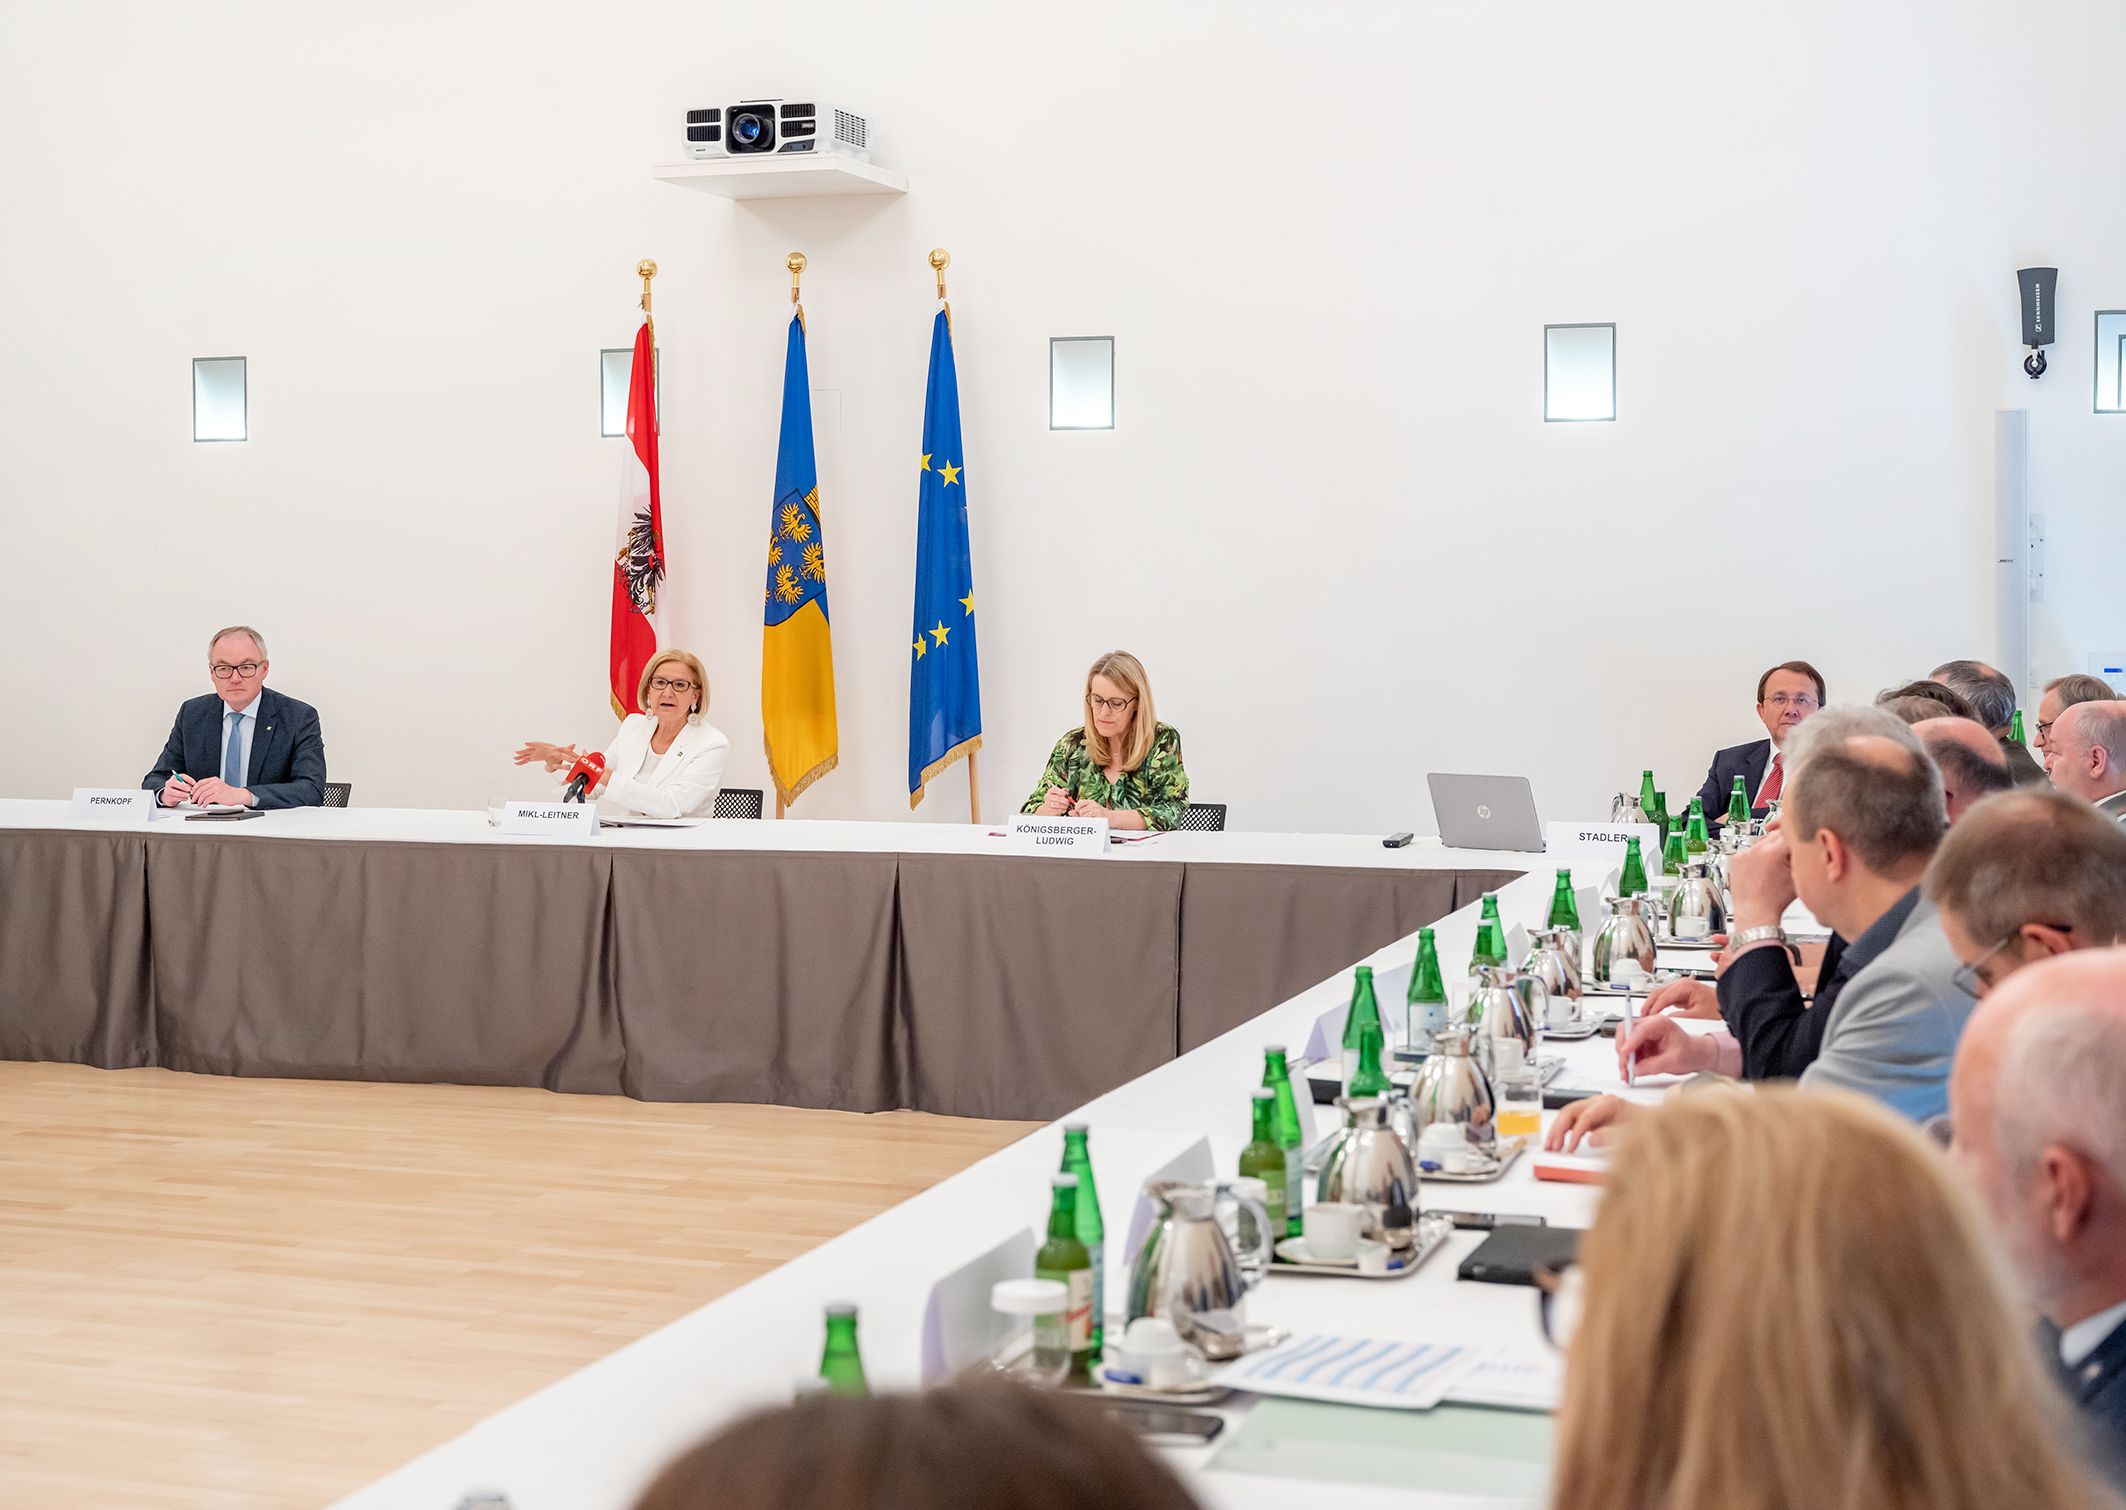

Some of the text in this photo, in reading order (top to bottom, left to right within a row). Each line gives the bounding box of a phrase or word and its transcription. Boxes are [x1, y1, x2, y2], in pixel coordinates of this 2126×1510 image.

[89, 796, 133, 805] PERNKOPF
[517, 810, 580, 819] MIKL-LEITNER
[1016, 823, 1097, 835] KÖNIGSBERGER-
[1035, 836, 1075, 846] LUDWIG
[1578, 832, 1628, 843] STADLER
